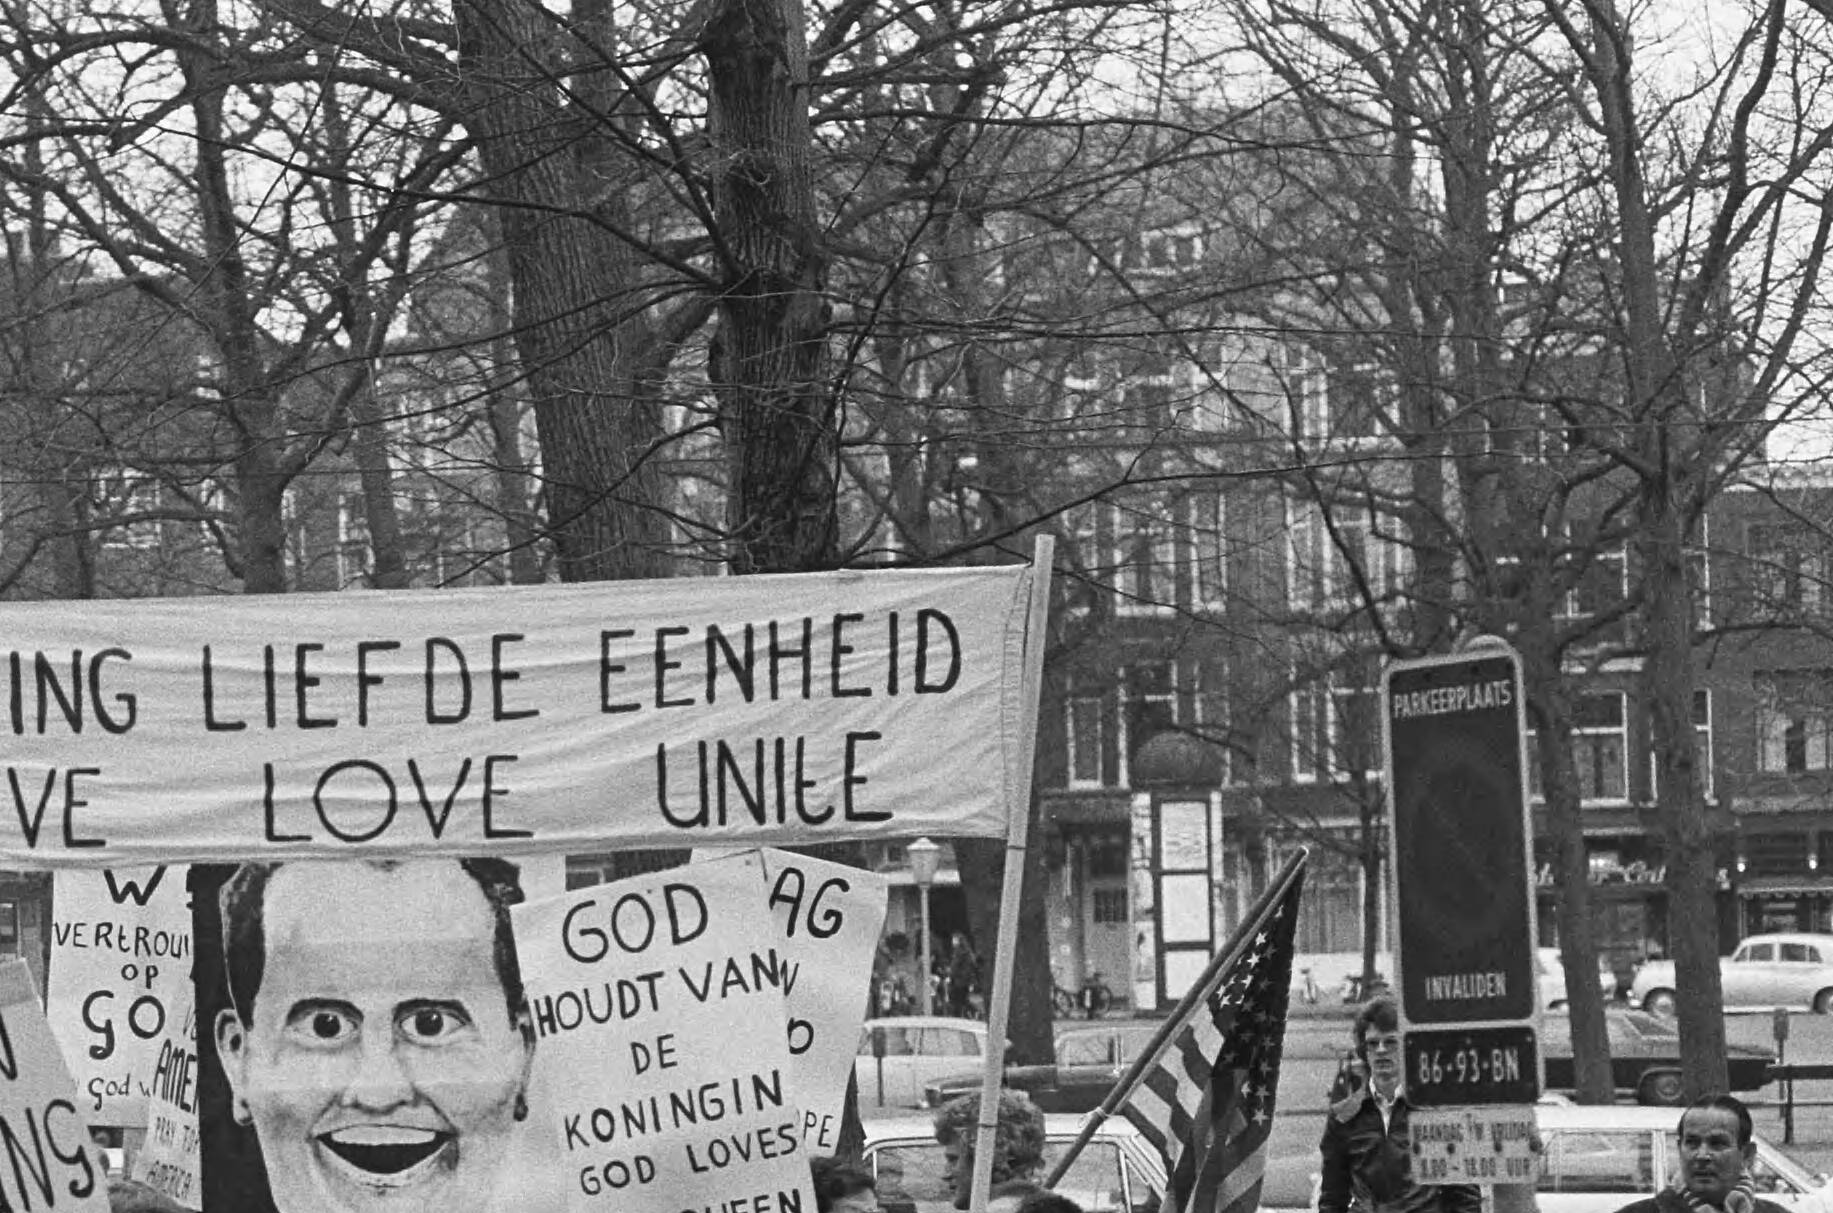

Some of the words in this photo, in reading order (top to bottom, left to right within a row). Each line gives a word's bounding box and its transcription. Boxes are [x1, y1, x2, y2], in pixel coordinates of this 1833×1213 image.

[202, 632, 540, 733] LIEFDE
[599, 607, 964, 715] EENHEID
[1393, 679, 1513, 719] PARKEERPLAATS
[263, 753, 535, 843] LOVE
[560, 882, 710, 964] GOD
[534, 969, 666, 1041] HOUDT
[678, 947, 780, 1003] VAN
[1424, 971, 1507, 1000] INVALIDEN
[631, 1034, 680, 1076] DE
[564, 1069, 783, 1152] KONINGIN
[579, 1155, 657, 1197] GOD
[686, 1122, 798, 1175] LOVES
